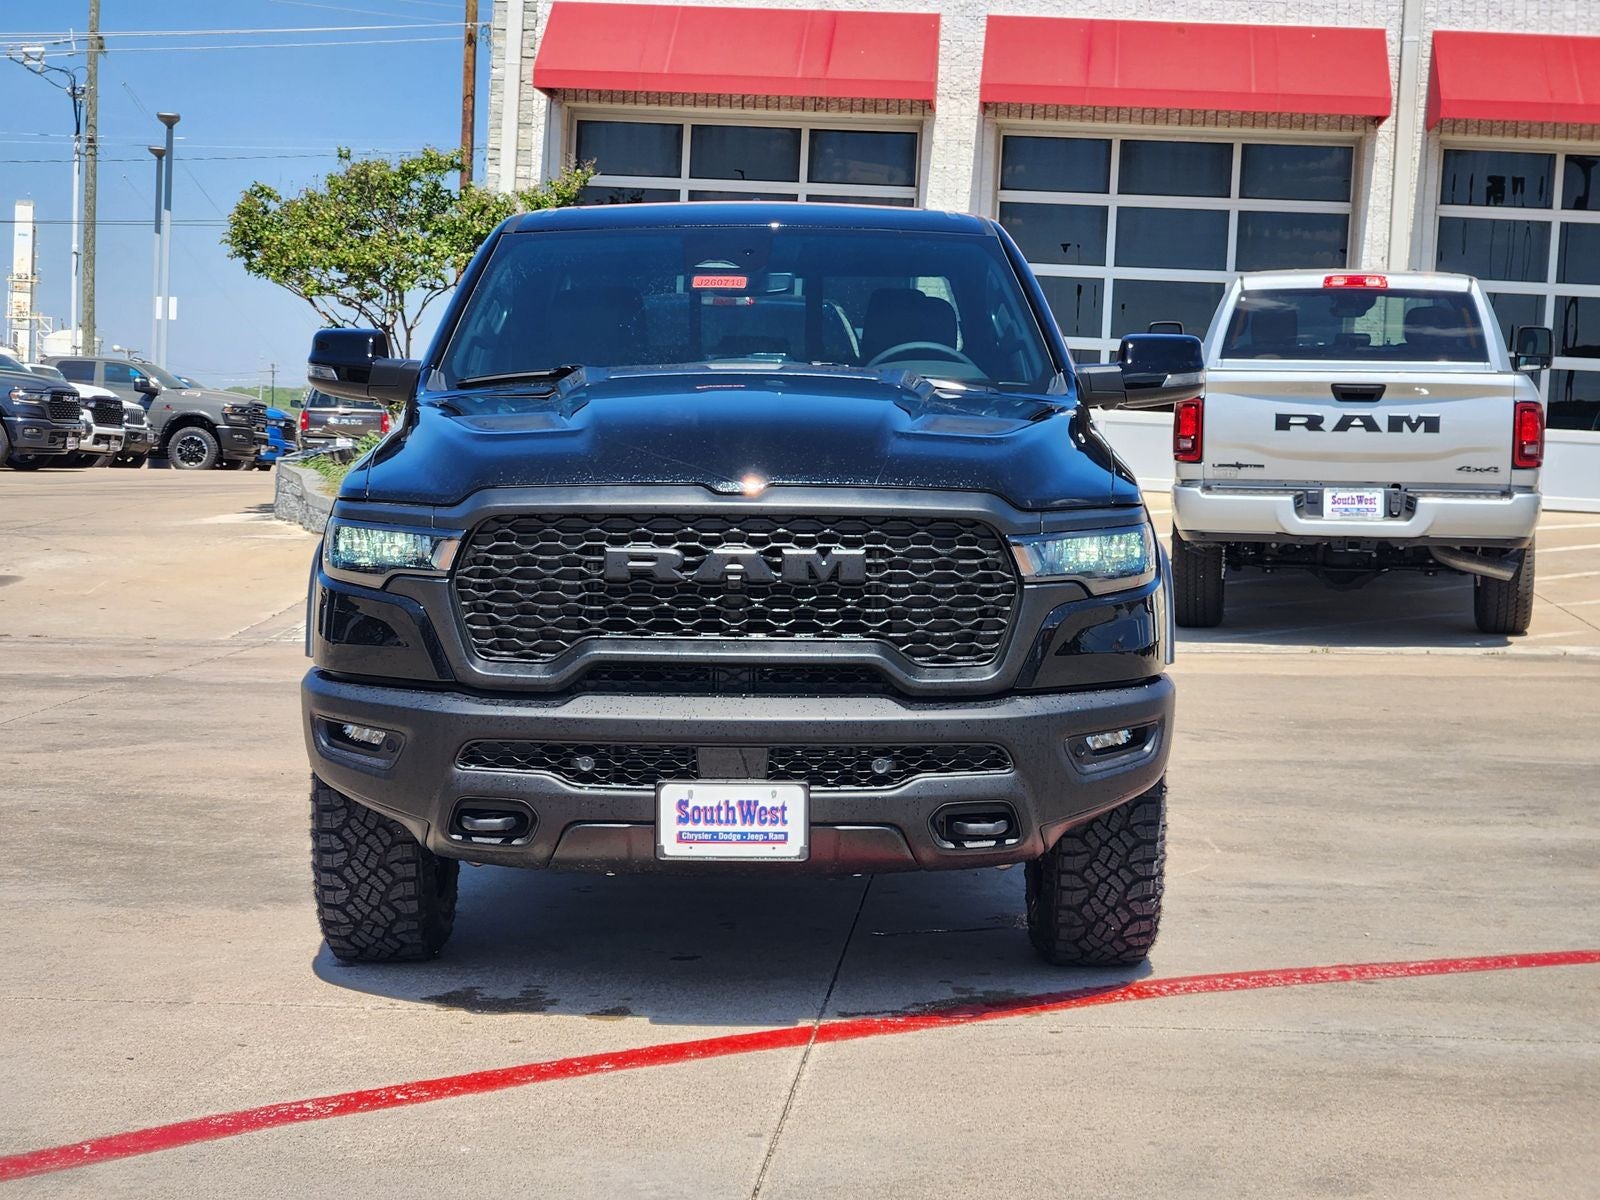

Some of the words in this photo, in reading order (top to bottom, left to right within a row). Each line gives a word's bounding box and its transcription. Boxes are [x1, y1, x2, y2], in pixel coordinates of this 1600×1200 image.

[1275, 413, 1440, 433] RAM
[1331, 494, 1377, 506] SouthWest
[603, 546, 867, 585] RAM
[676, 799, 788, 826] SouthWest
[682, 832, 712, 841] Chrysler
[718, 832, 741, 841] Dodge
[747, 832, 764, 841] Jeep
[768, 832, 785, 841] Ram
